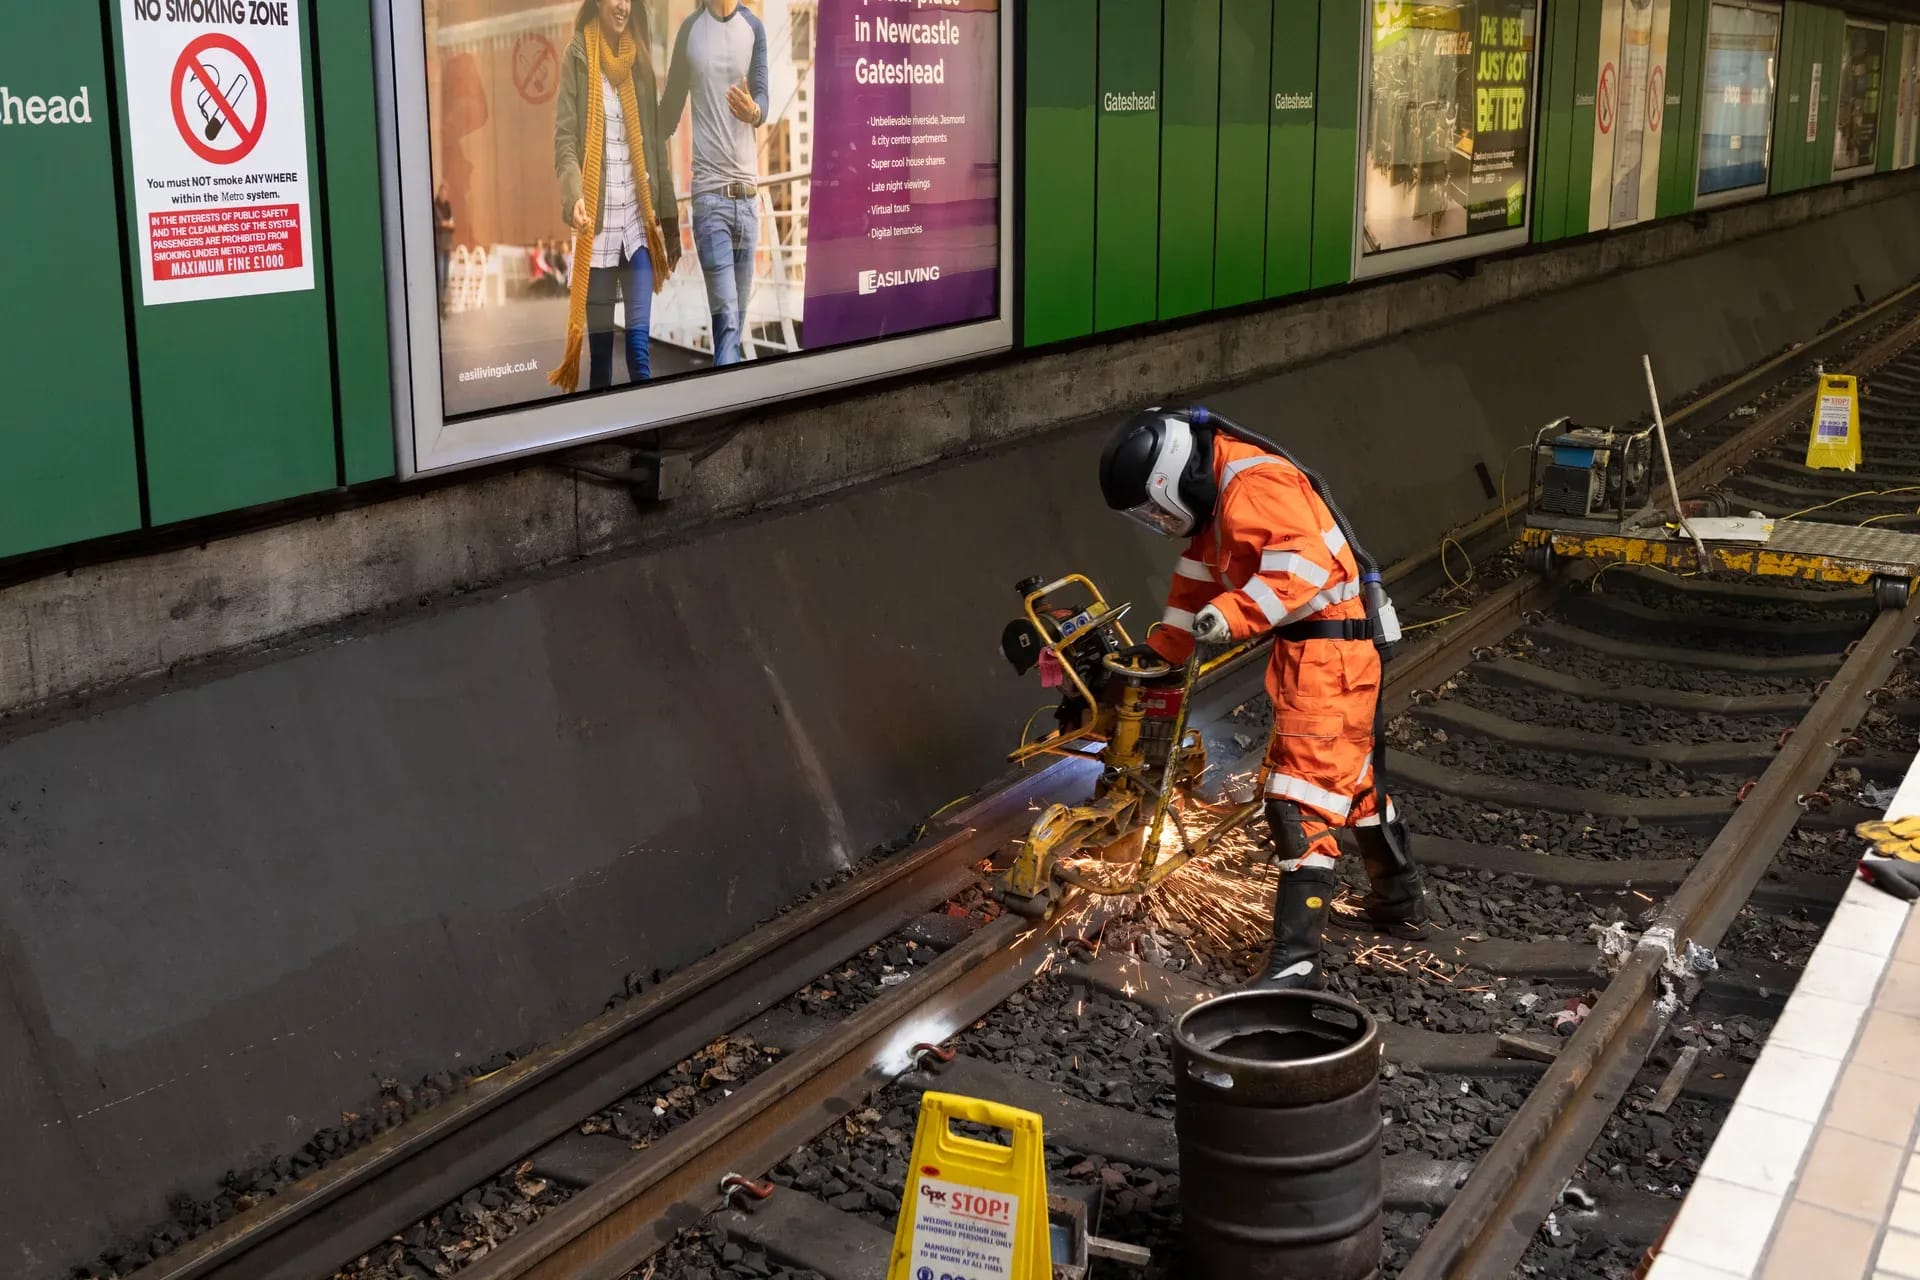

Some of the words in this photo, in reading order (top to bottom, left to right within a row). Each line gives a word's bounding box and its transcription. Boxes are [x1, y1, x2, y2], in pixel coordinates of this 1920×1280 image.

[134, 0, 161, 21] NO
[166, 0, 245, 24] SMOKING
[249, 0, 288, 26] ZONE
[855, 14, 870, 42] in
[876, 16, 960, 45] Newcastle
[1480, 15, 1498, 46] THE
[1502, 17, 1524, 47] BEST
[855, 57, 944, 85] Gateshead
[1477, 51, 1505, 81] JUST
[1506, 51, 1527, 81] GOT
[0, 86, 93, 125] head
[1104, 90, 1156, 112] Gateshead
[1274, 91, 1313, 110] Gateshead
[1477, 87, 1525, 133] BETTER
[870, 115, 912, 127] Unbelievable
[940, 113, 966, 125] Jesmond
[871, 135, 877, 146] &
[877, 134, 890, 148] city
[890, 134, 911, 145] centre
[911, 133, 948, 146] apartments
[871, 158, 890, 171] Super
[891, 157, 905, 168] cool
[906, 156, 924, 167] house
[925, 155, 946, 166] shares
[146, 178, 165, 189] You
[166, 177, 191, 188] must
[191, 176, 211, 187] NOT
[213, 175, 243, 186] smoke
[244, 172, 298, 184] ANYWHERE
[871, 181, 885, 193] Late
[886, 180, 903, 193] night
[903, 179, 931, 191] viewings
[171, 193, 201, 204] within
[203, 192, 219, 202] the
[221, 191, 244, 202] Metro
[246, 190, 280, 201] system.
[151, 216, 160, 226] IN
[161, 215, 178, 225] THE
[178, 212, 221, 225] INTERESTS
[221, 212, 232, 221] OF
[233, 210, 261, 220] PUBLIC
[261, 208, 289, 218] SAFETY
[871, 203, 893, 215] Virtual
[893, 203, 910, 213] tours
[152, 227, 170, 238] AND
[171, 226, 187, 236] THE
[188, 223, 239, 235] CLEANLINESS
[240, 222, 251, 232] OF
[252, 221, 268, 231] THE
[153, 238, 204, 250] PASSENGERS
[205, 236, 221, 246] ARE
[221, 232, 266, 244] PROHIBITED
[267, 231, 289, 240] FROM
[871, 226, 892, 240] Digital
[893, 223, 923, 236] tenancies
[154, 250, 191, 261] SMOKING
[192, 248, 219, 258] UNDER
[220, 246, 247, 256] METRO
[171, 258, 224, 277] MAXIMUM
[227, 257, 251, 270] FINE
[253, 254, 284, 269] £1000
[867, 265, 940, 290] EASILIVING
[458, 358, 538, 382] easilivinguk.co.uk
[951, 1192, 1010, 1220] STOP!
[916, 1223, 957, 1237] AUTHORISED
[995, 1239, 1012, 1249] ONLY
[923, 1215, 953, 1227] WELDING
[954, 1222, 989, 1235] EXCLUSION
[990, 1229, 1007, 1239] ZONE
[920, 1249, 929, 1257] TO
[929, 1251, 938, 1260] BE
[939, 1253, 961, 1264] WORN
[971, 1260, 983, 1269] ALL
[984, 1262, 1003, 1273] TIMES
[924, 1241, 965, 1257] MANDATORY
[987, 1254, 1001, 1264] PPE
